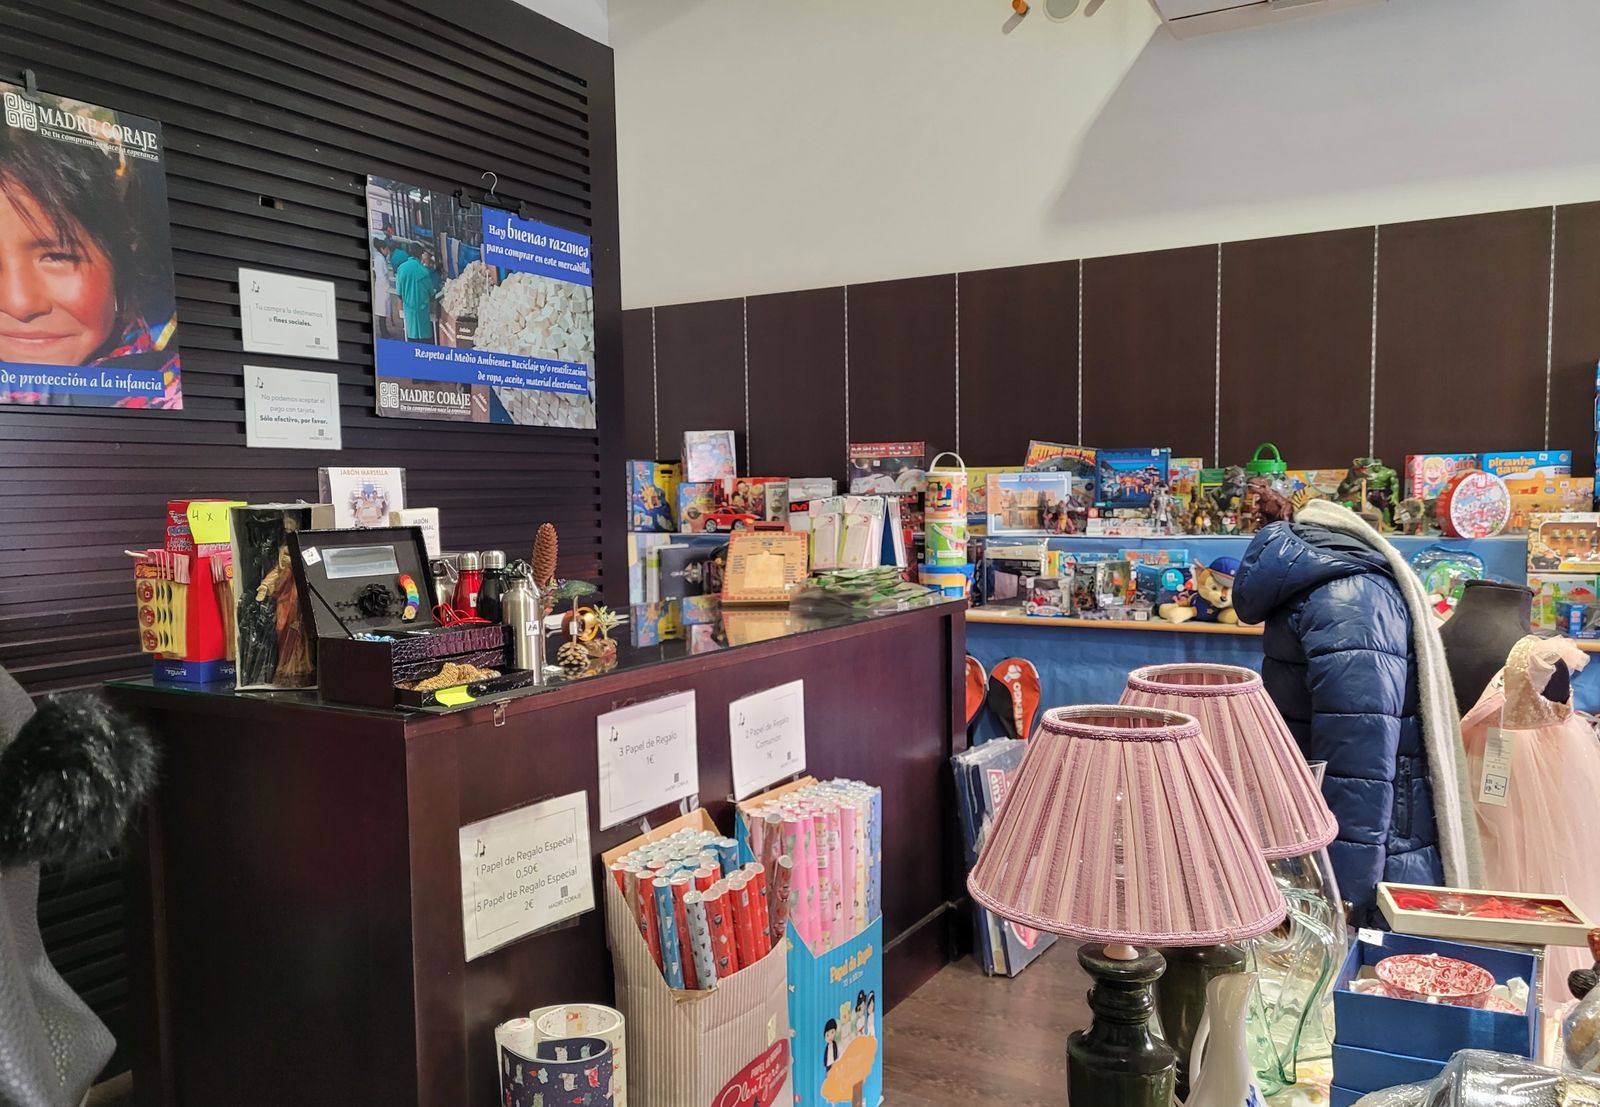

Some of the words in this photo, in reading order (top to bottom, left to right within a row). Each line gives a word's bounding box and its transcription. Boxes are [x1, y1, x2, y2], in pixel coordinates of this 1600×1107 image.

[39, 105, 98, 136] MADRE
[101, 121, 158, 151] CORAJE
[40, 128, 51, 136] De
[52, 130, 60, 139] tu
[127, 148, 159, 160] esperanza
[488, 224, 506, 240] Hay
[507, 218, 546, 247] buenas
[548, 237, 588, 258] razones
[486, 243, 504, 254] para
[505, 248, 534, 262] comprar
[535, 254, 543, 263] en
[544, 257, 557, 266] este
[558, 260, 590, 275] mercadillo
[415, 348, 445, 361] Respeto
[446, 350, 453, 361] al
[454, 352, 476, 364] Medio
[477, 355, 511, 368] Ambiente:
[512, 359, 538, 372] Reciclaje
[539, 363, 550, 374] y/o
[551, 365, 586, 377] reutilización
[1, 369, 16, 384] de
[19, 372, 87, 387] protección
[90, 378, 98, 388] a
[101, 372, 112, 388] la
[115, 373, 162, 392] infancia
[477, 370, 486, 381] de
[486, 373, 503, 384] ropa,
[504, 375, 525, 386] aceite,
[526, 377, 551, 388] material
[400, 388, 435, 404] MADRE
[437, 391, 471, 408] CORAJE
[1488, 456, 1536, 468] piranha
[1496, 466, 1530, 474] game
[192, 509, 199, 520] 4
[1013, 682, 1024, 737] ARTENGO
[620, 747, 623, 757] 3
[626, 741, 644, 755] Papel
[646, 738, 655, 748] de
[656, 730, 677, 745] Regalo
[481, 858, 503, 876] Papel
[505, 855, 515, 866] de
[516, 846, 543, 862] Regalo
[545, 834, 574, 851] Especial
[476, 903, 481, 912] 5
[484, 894, 505, 911] Papel
[507, 889, 517, 900] de
[520, 879, 545, 898] Regalo
[547, 866, 578, 885] Especial
[524, 899, 534, 911] 2€
